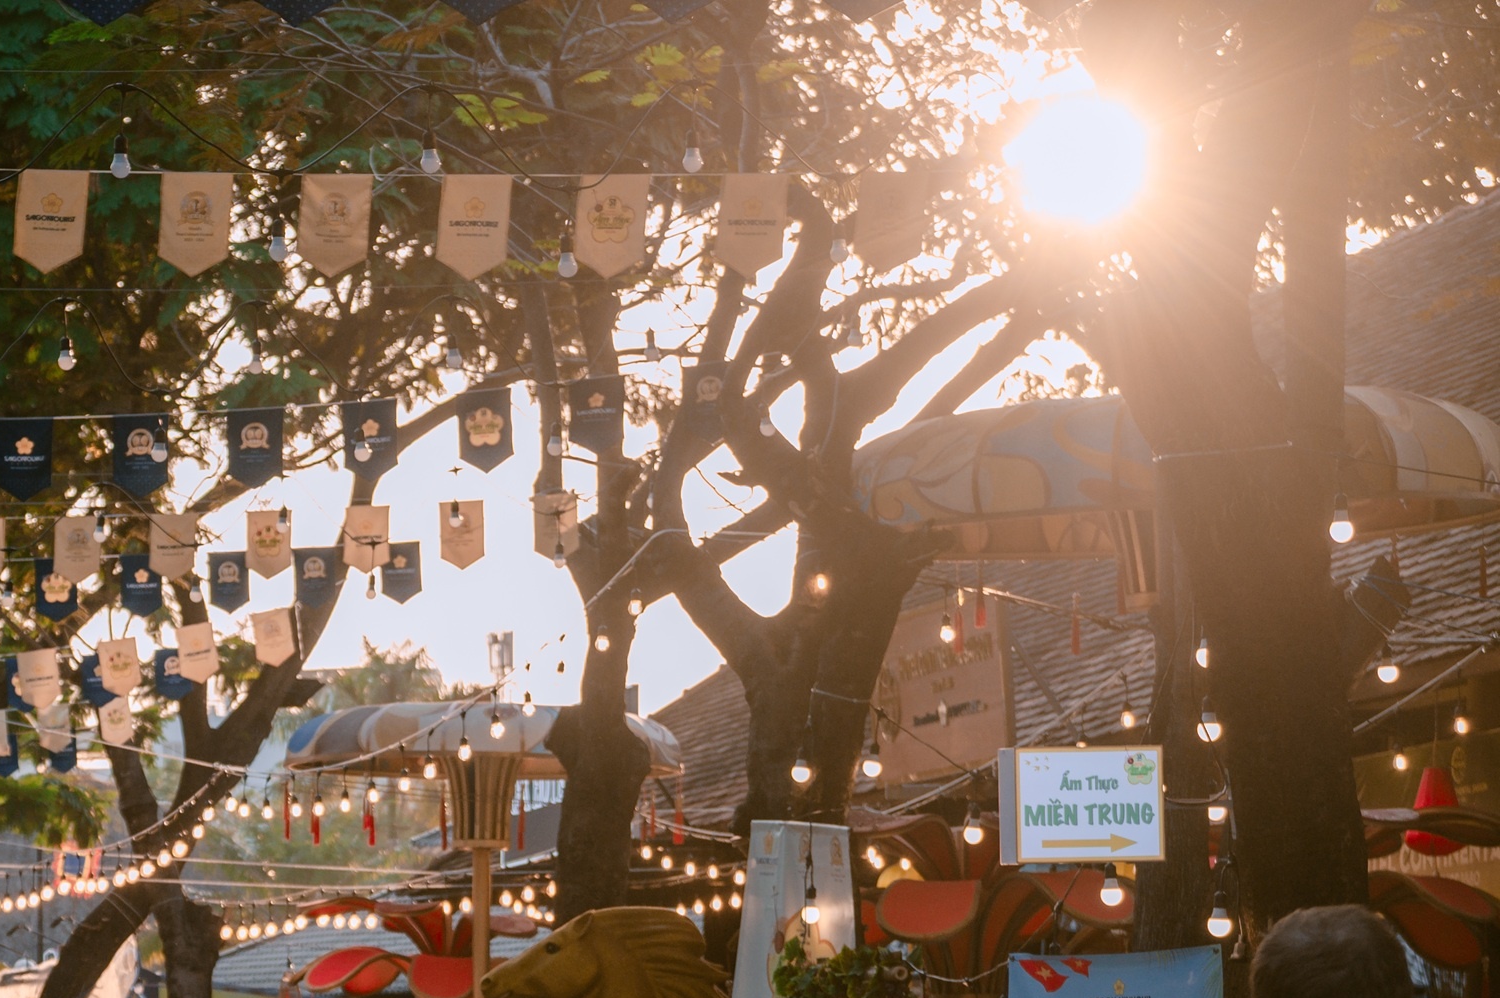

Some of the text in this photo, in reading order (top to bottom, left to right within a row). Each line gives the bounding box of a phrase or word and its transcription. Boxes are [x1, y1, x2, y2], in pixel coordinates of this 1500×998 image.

[1085, 775, 1119, 793] Thực
[1024, 798, 1155, 827] MIỀN TRUNG
